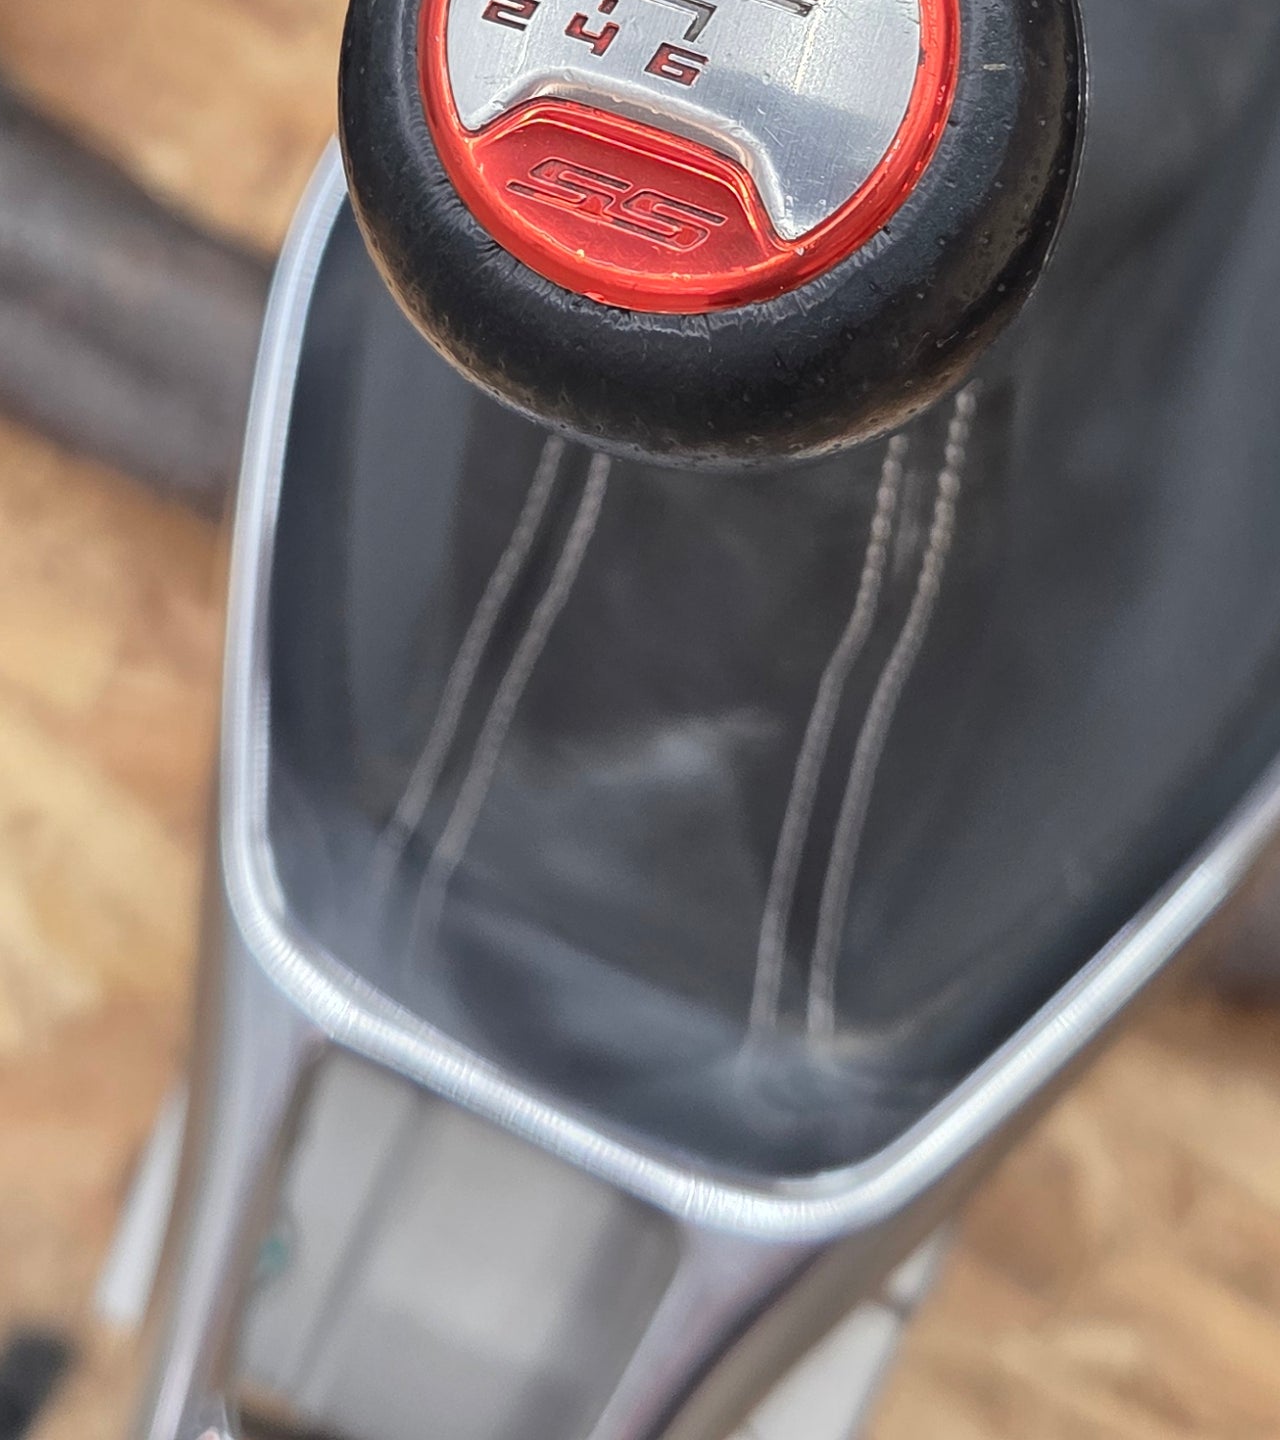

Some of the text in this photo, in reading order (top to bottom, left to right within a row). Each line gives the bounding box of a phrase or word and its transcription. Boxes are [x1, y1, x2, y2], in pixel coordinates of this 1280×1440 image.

[564, 12, 621, 57] 4
[644, 42, 710, 87] 6
[505, 156, 729, 252] SS
